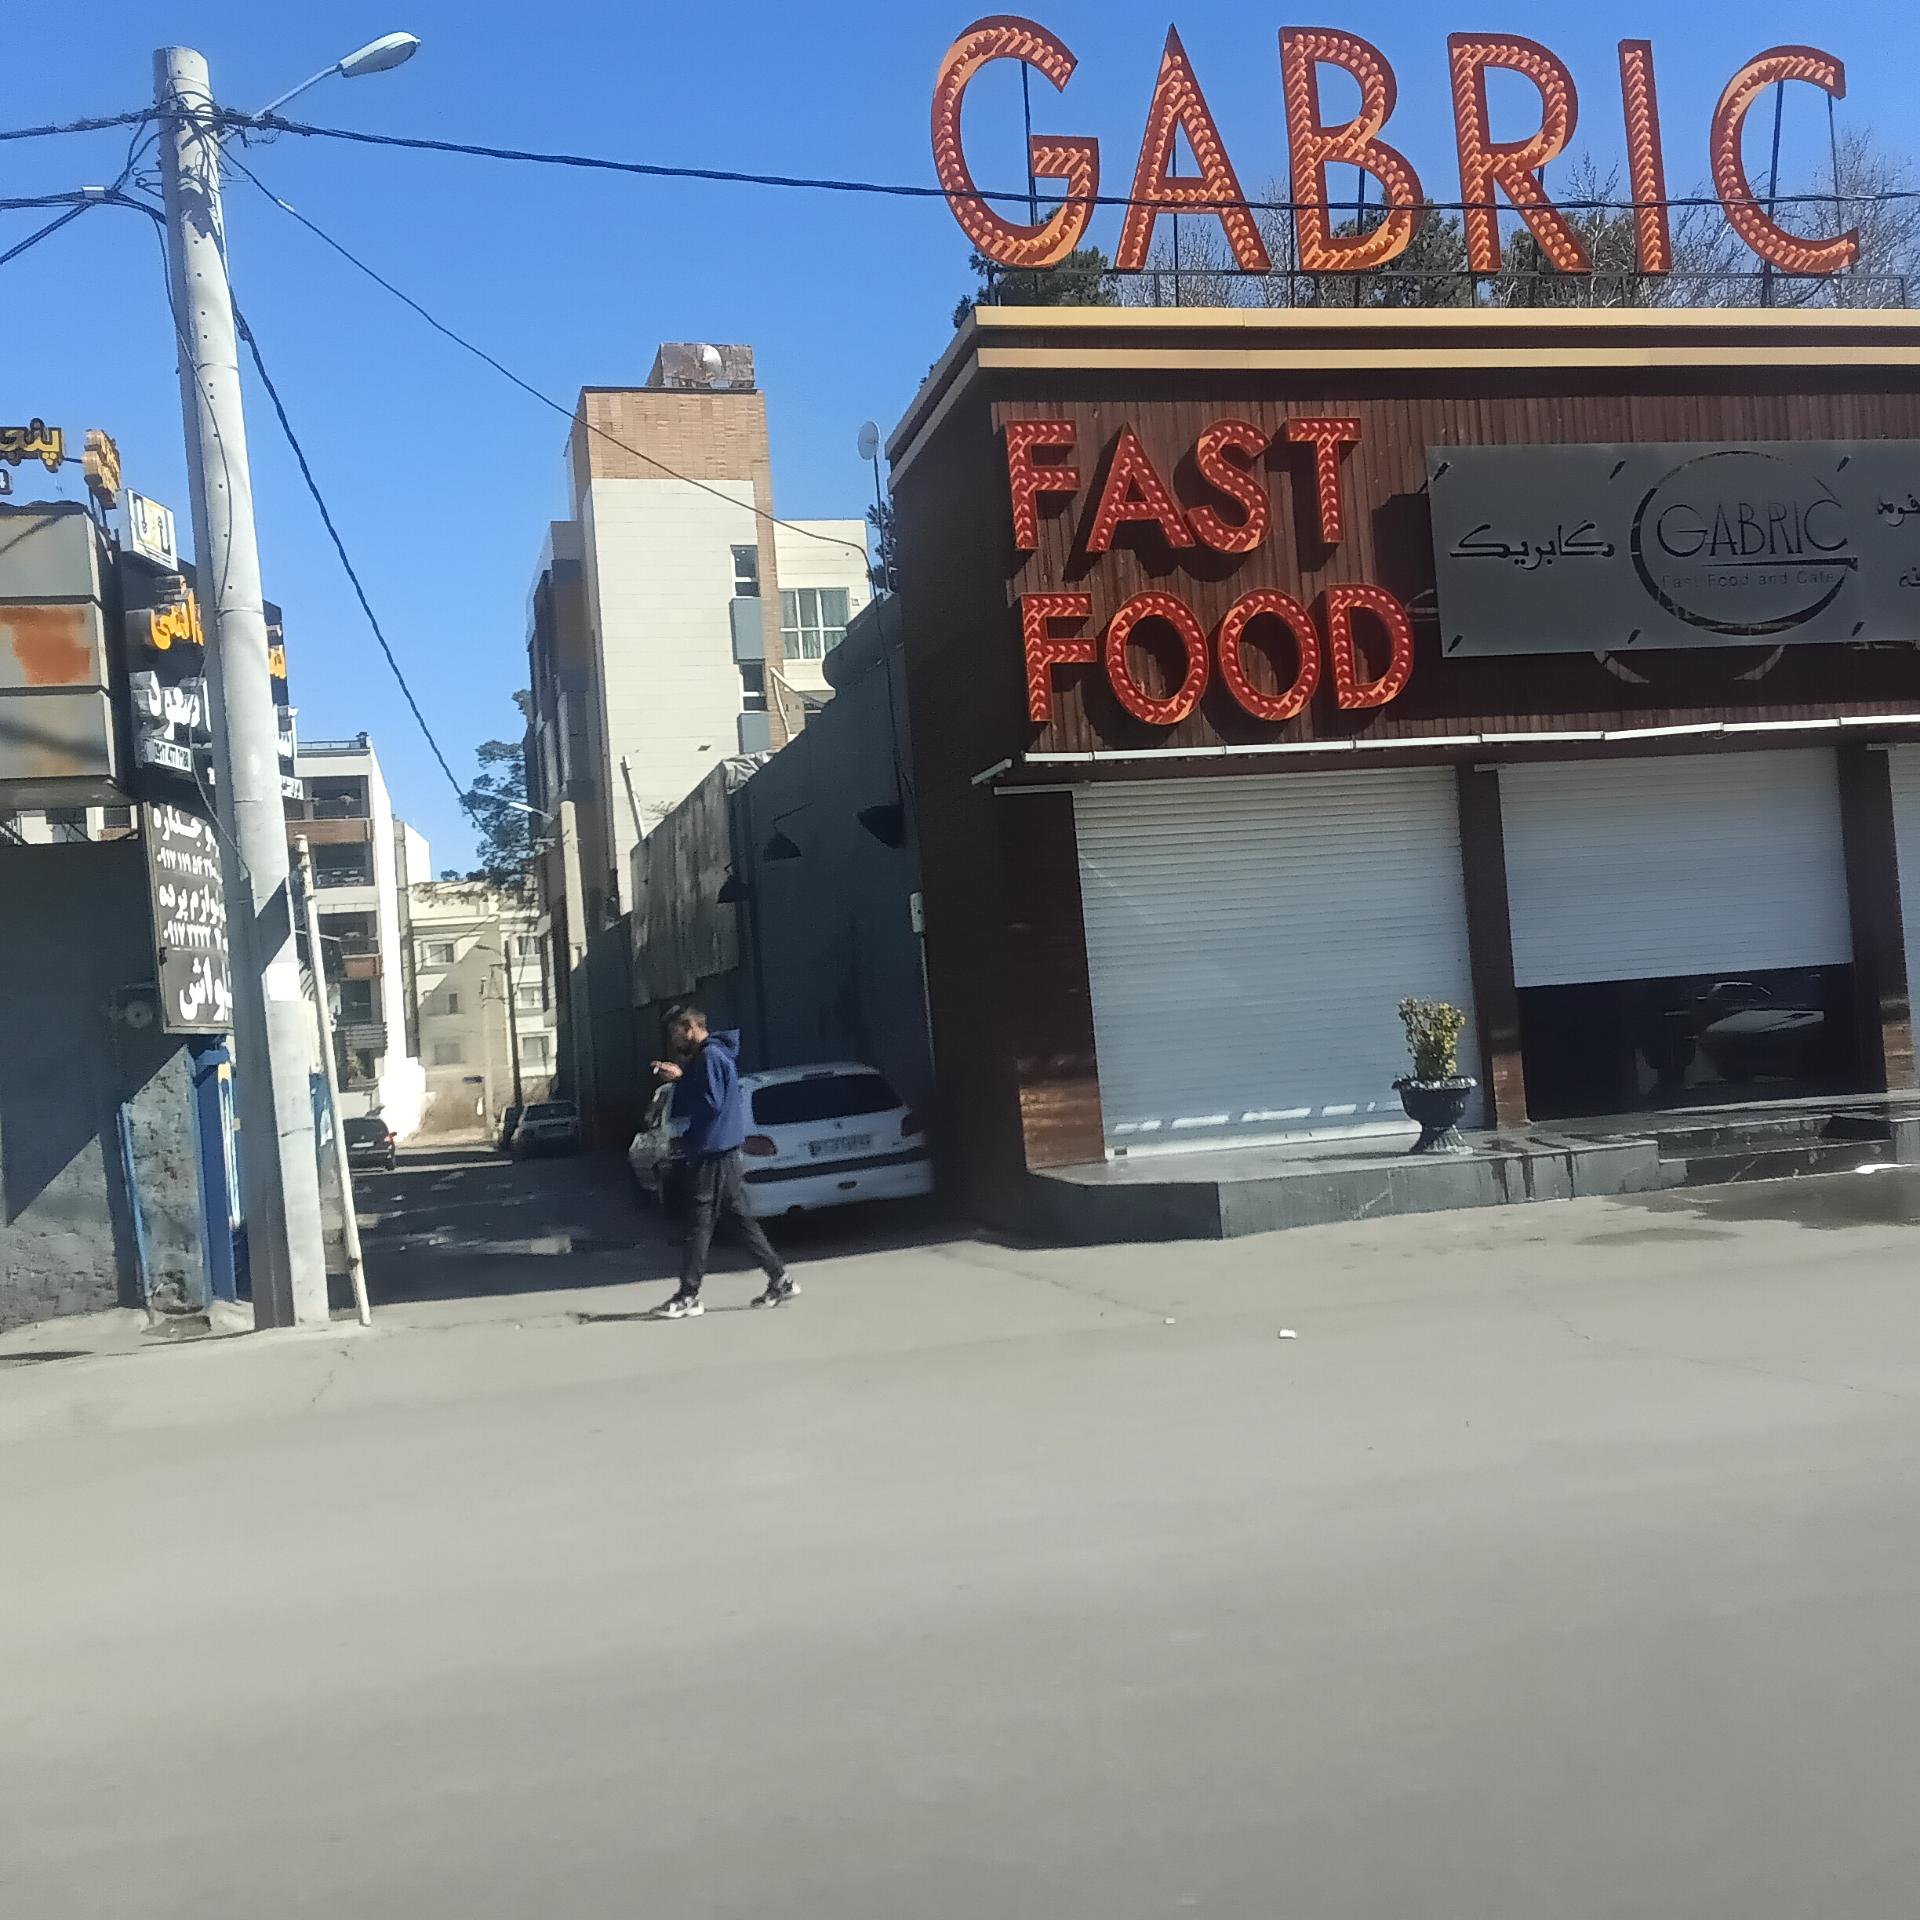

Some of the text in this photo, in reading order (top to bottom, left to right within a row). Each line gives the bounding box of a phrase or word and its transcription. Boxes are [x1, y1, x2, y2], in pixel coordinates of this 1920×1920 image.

[932, 15, 1859, 274] GABRIC
[1006, 417, 1361, 552] FAST
[1657, 500, 1848, 557] GABRIC
[1759, 571, 1788, 585] and
[1021, 583, 1414, 725] FOOD
